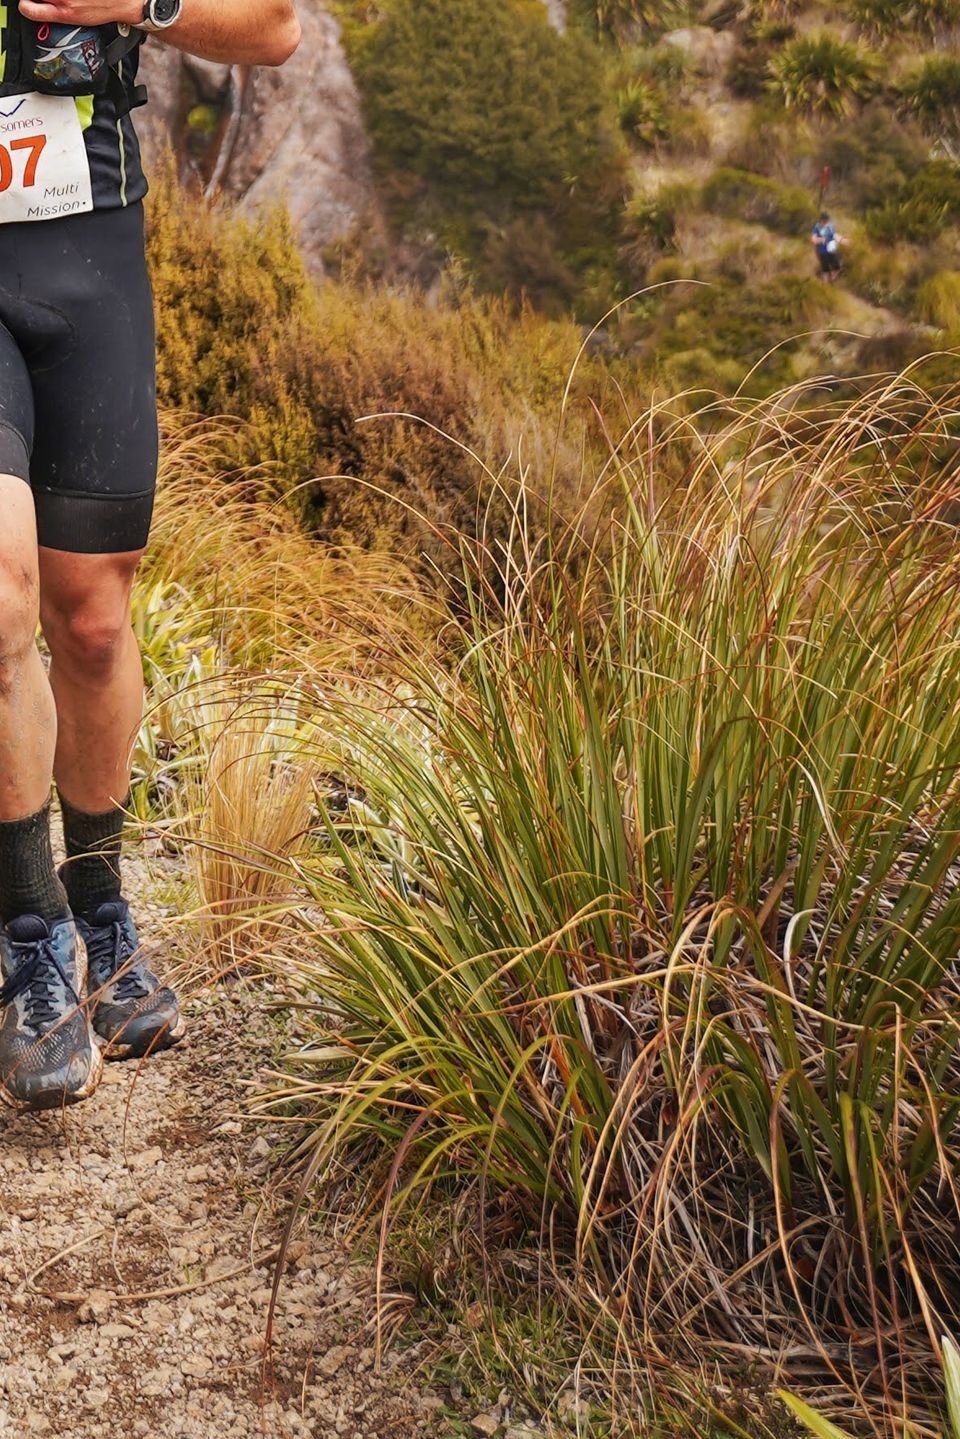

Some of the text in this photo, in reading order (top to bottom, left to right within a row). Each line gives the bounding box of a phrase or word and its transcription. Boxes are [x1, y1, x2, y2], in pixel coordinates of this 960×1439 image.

[0, 117, 44, 133] somers
[43, 181, 80, 199] Multi
[27, 200, 80, 217] Mission
